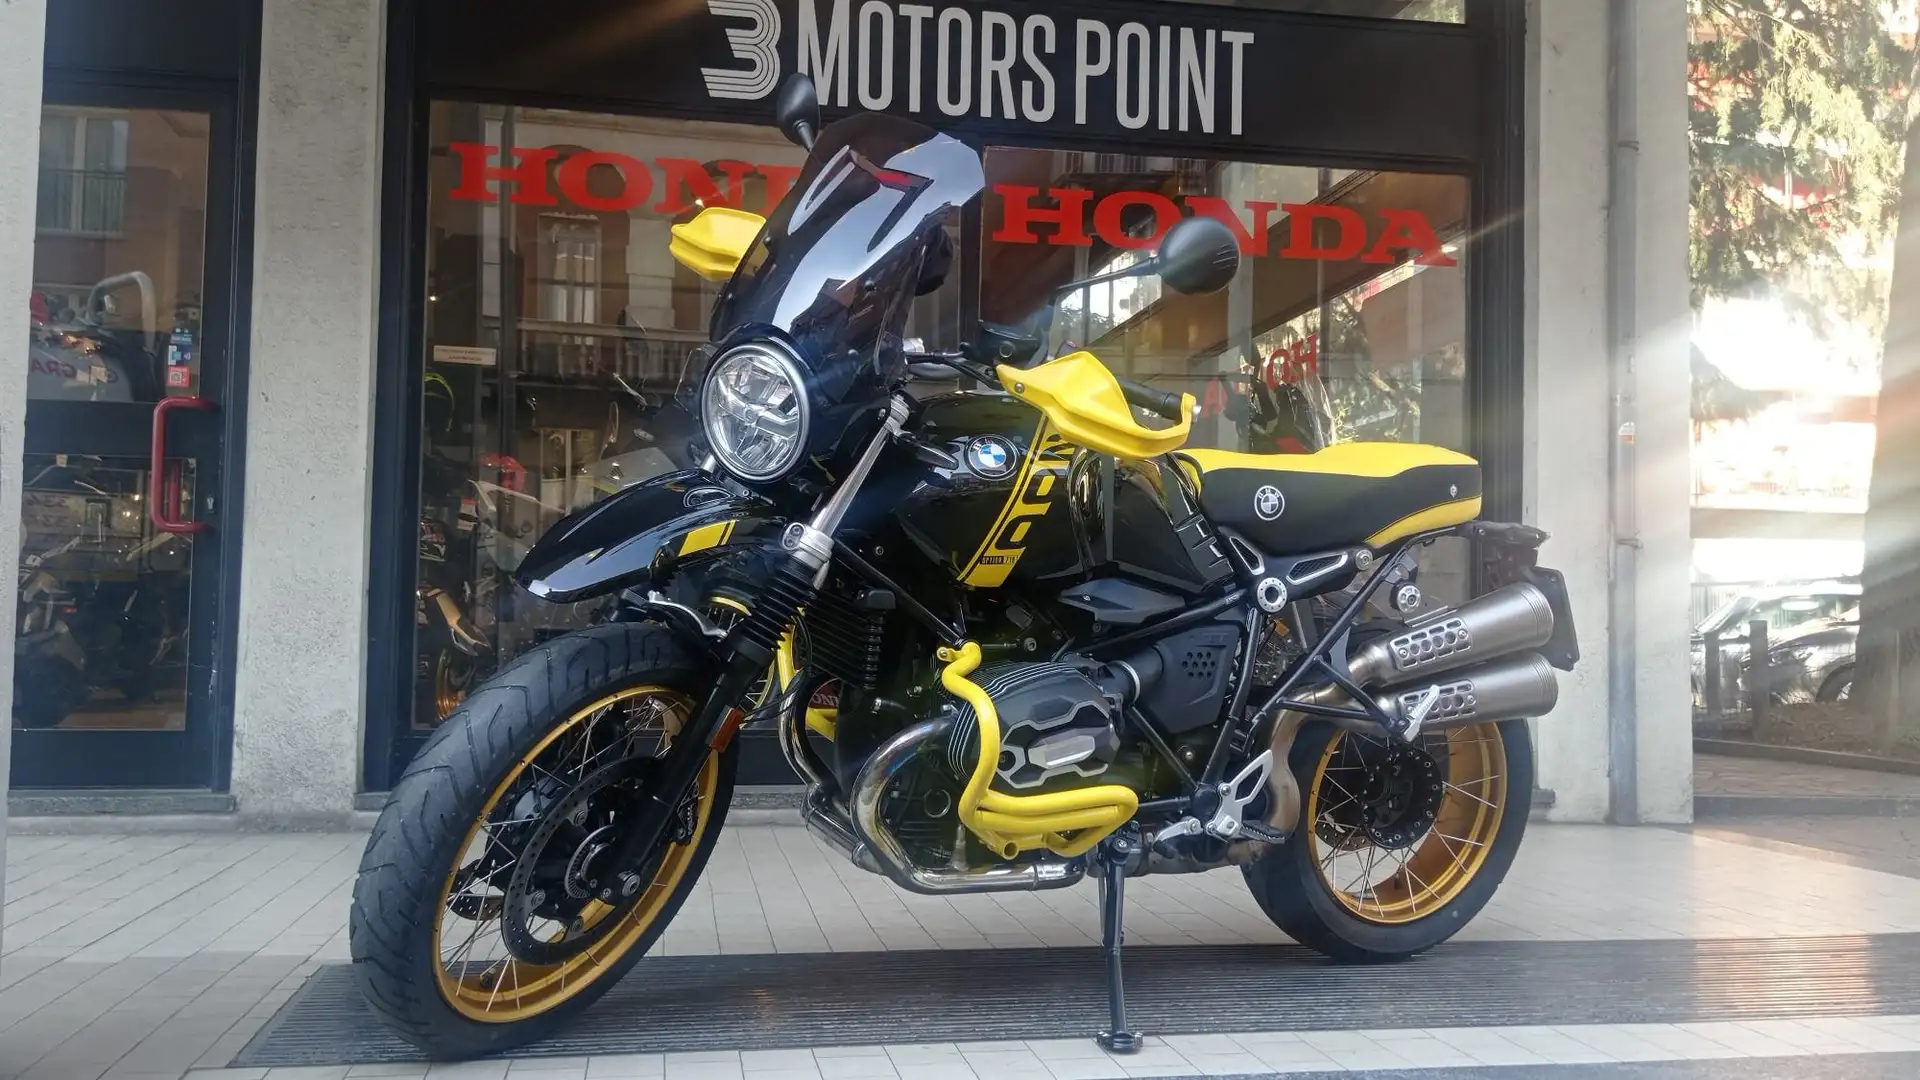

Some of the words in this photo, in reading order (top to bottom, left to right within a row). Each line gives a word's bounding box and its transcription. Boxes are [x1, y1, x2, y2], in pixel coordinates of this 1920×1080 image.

[701, 0, 782, 99] 3
[797, 0, 1056, 124] MOTORS
[1074, 18, 1255, 136] POINT
[450, 142, 802, 213] HON
[993, 184, 1458, 267] HONDA
